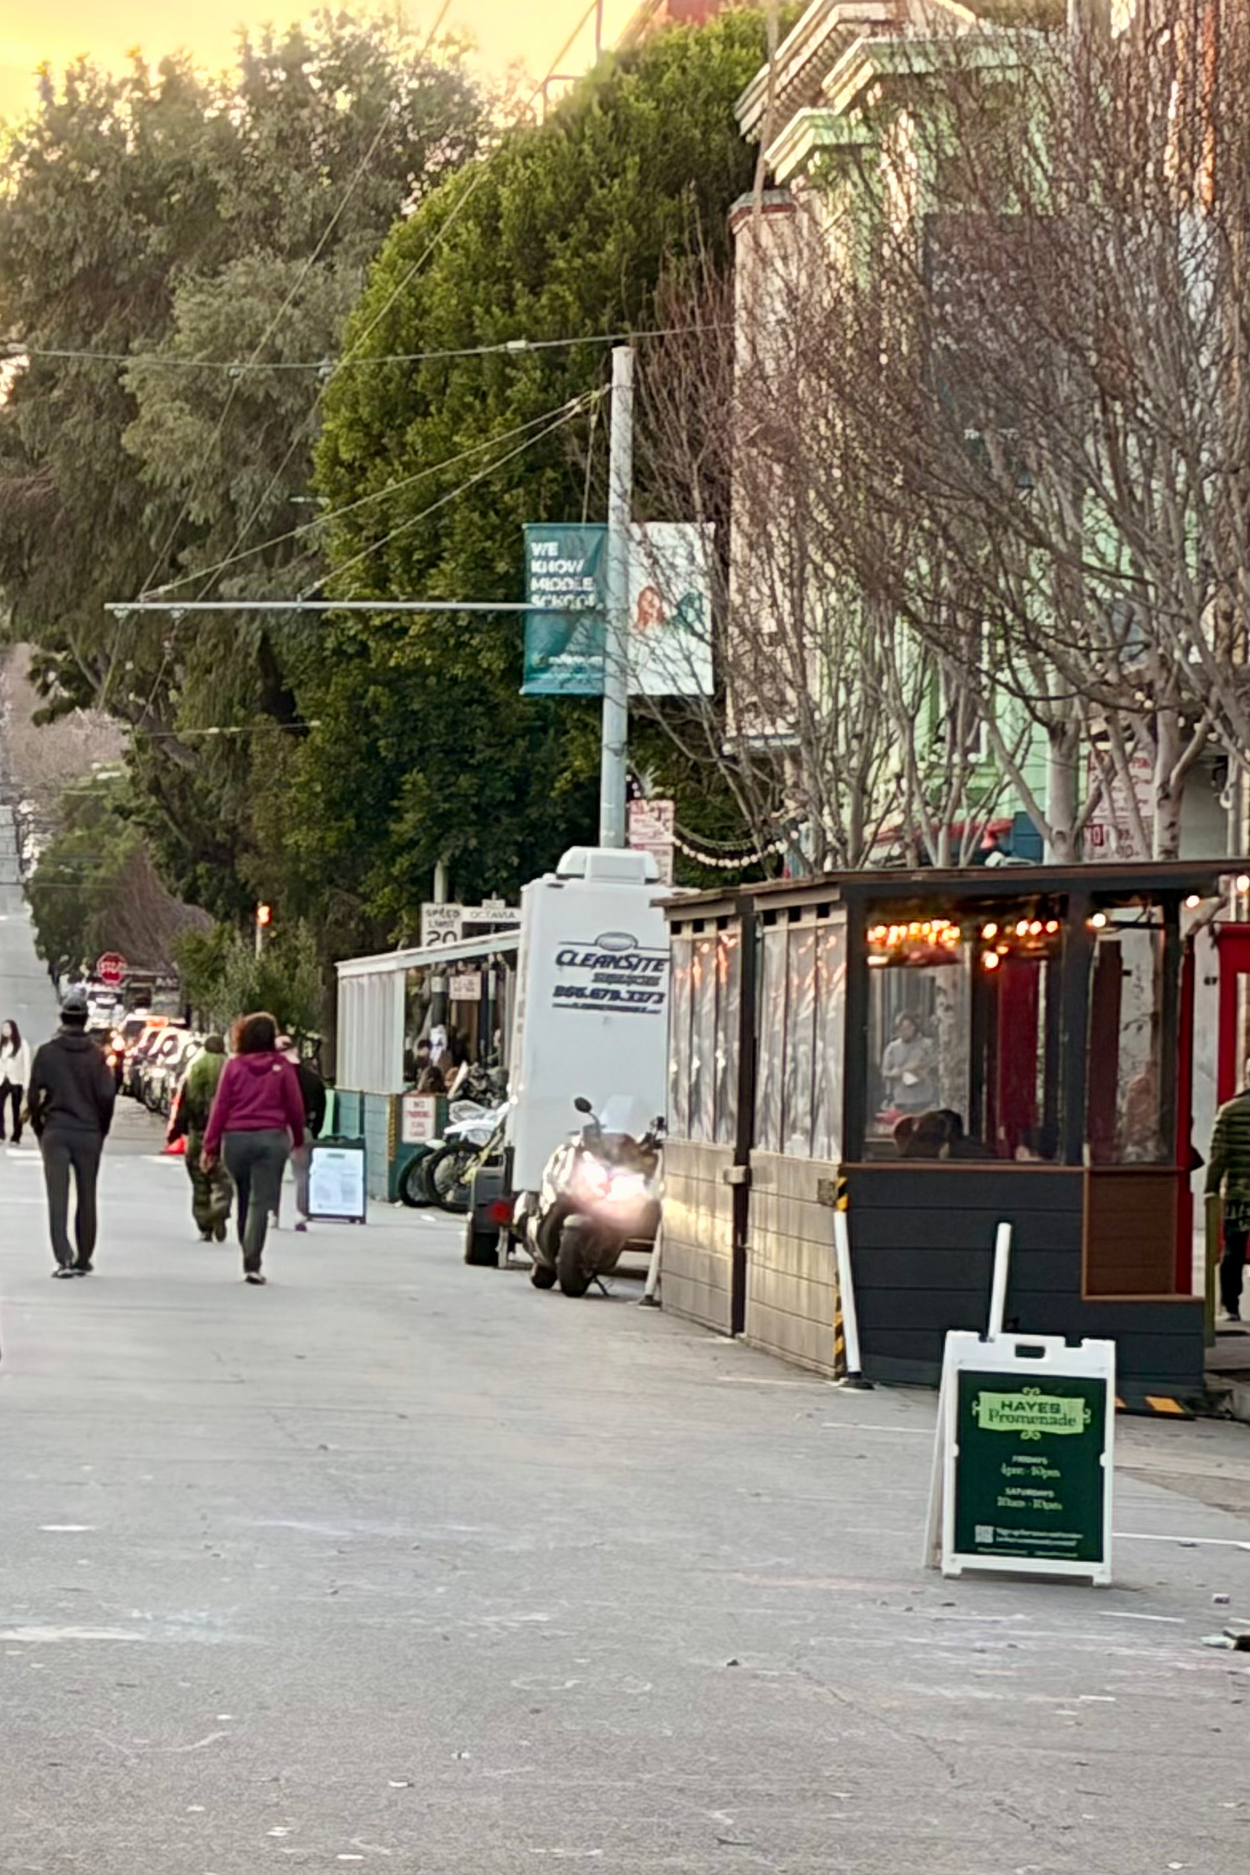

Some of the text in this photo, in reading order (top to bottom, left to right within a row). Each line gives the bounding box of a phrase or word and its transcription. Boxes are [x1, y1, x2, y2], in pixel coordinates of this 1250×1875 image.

[530, 542, 558, 557] WE
[531, 559, 584, 574] KNOW
[531, 577, 595, 591] MIDDLE
[426, 908, 460, 919] SPEED
[470, 911, 516, 919] OCTAVIA
[429, 921, 454, 929] LIMIT
[426, 930, 458, 947] 20
[100, 961, 126, 974] STOP
[1000, 1400, 1061, 1414] HAYES
[988, 1408, 1077, 1426] Promenade
